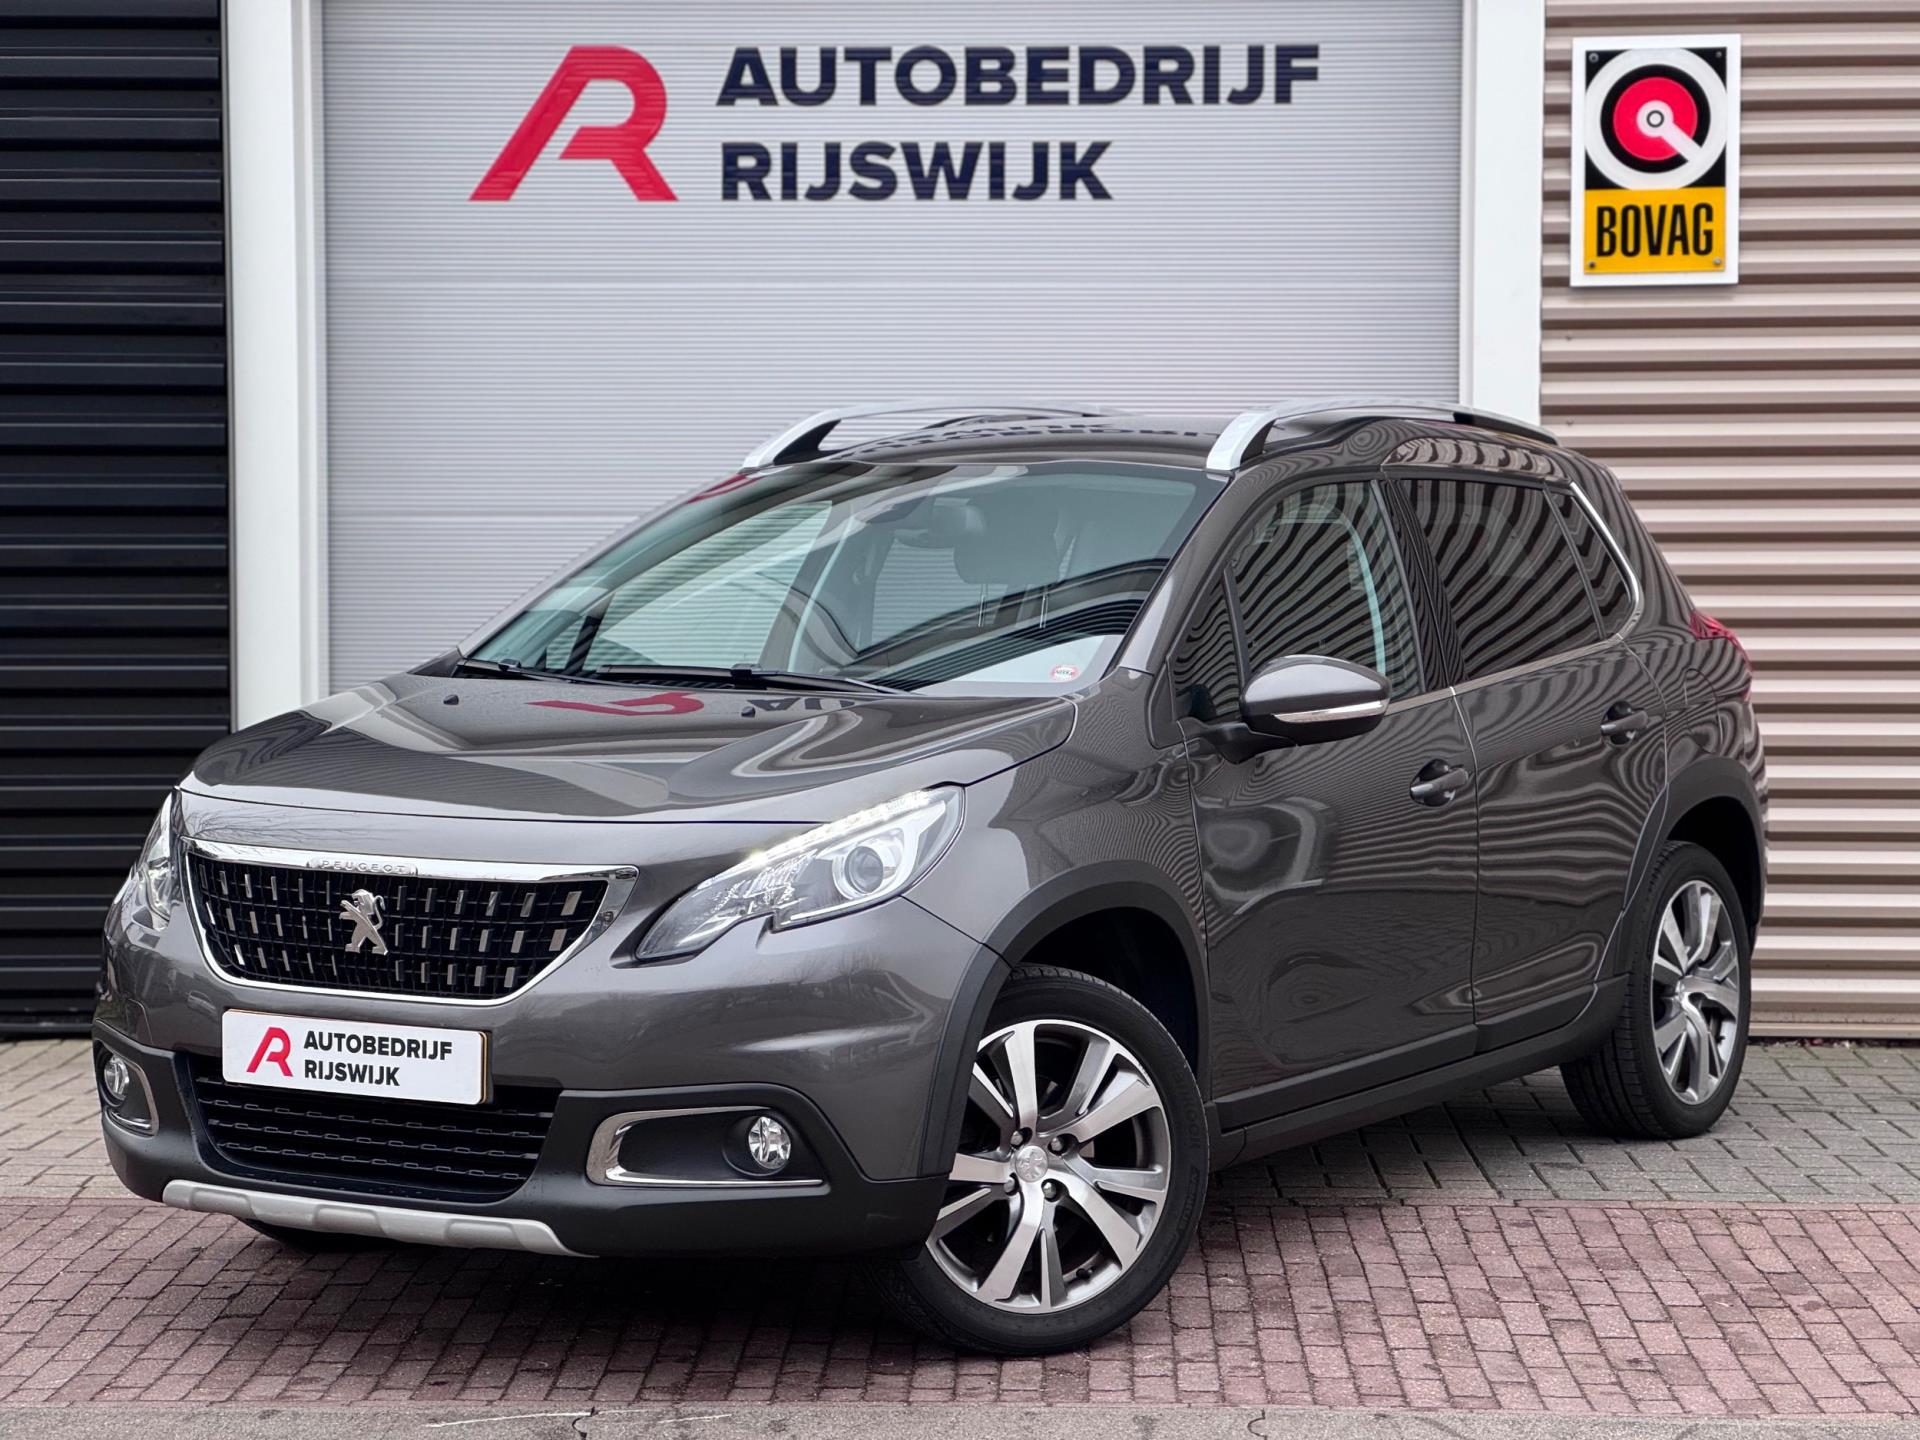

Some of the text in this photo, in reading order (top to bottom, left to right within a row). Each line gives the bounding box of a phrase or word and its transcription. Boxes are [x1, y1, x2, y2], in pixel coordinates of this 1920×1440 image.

[717, 45, 1320, 106] AUTOBEDRIJF
[721, 141, 1113, 200] RIJSWIJK
[1596, 203, 1713, 257] BOVAG
[321, 859, 405, 873] PEUGEOT
[304, 1030, 453, 1061] AUTOBEDRIJF
[304, 1060, 400, 1086] RIJSWIJK
